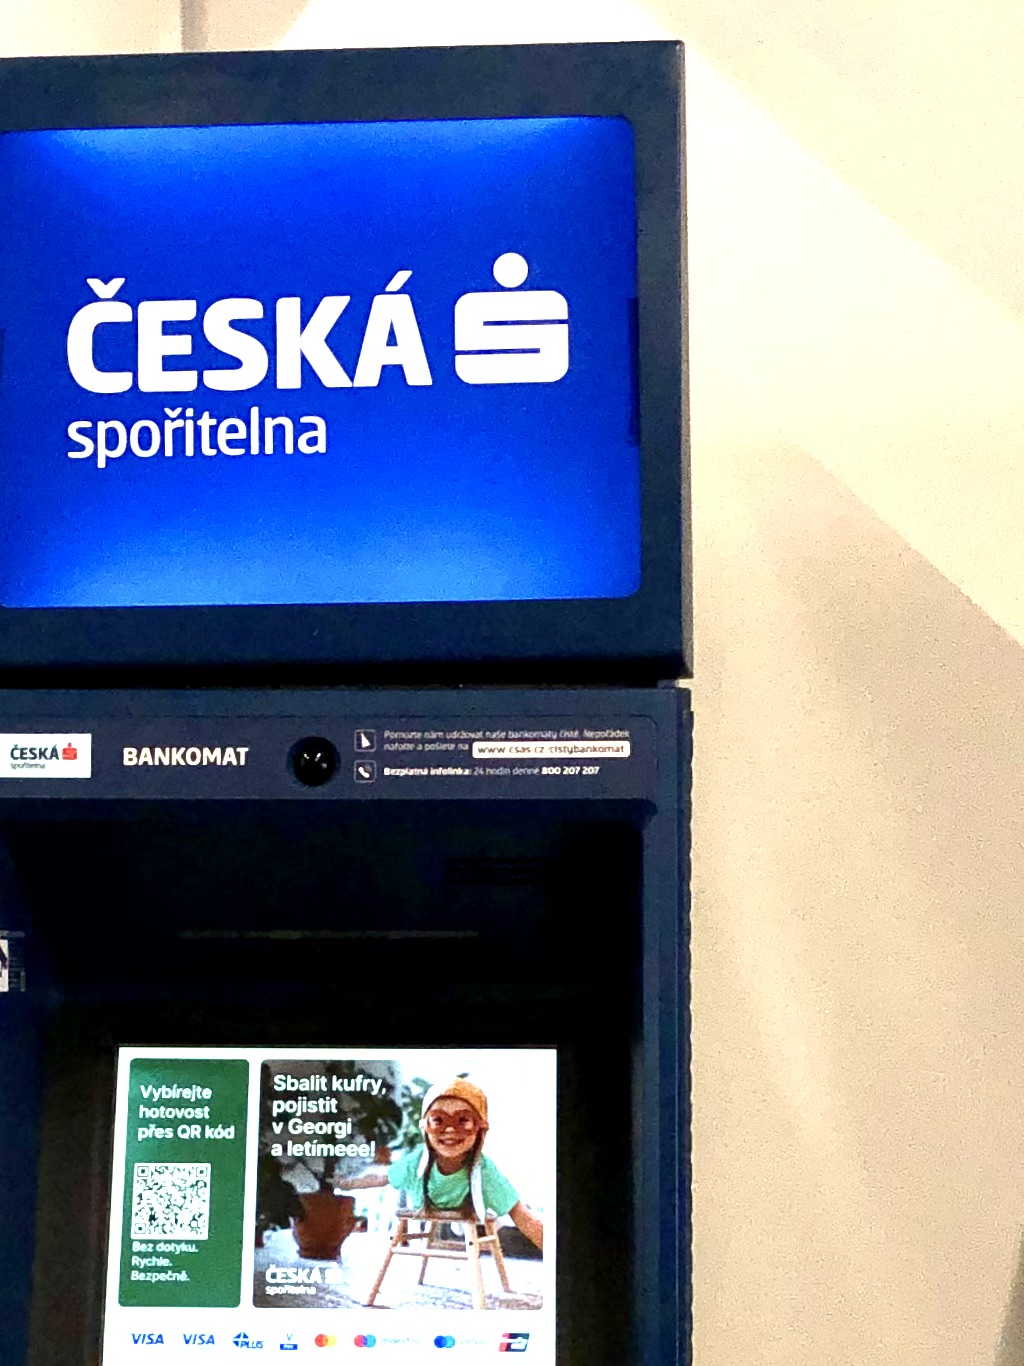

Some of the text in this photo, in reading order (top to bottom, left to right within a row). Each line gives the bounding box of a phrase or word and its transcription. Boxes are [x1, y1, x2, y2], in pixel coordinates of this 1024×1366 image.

[67, 270, 433, 394] ČESKÁ
[67, 406, 328, 468] spořitelna
[10, 744, 59, 761] ČESKÁ
[123, 747, 249, 766] BANKOMAT
[541, 766, 561, 775] 800
[562, 766, 581, 775] 207
[582, 766, 600, 775] 207
[140, 1083, 213, 1102] Vybírejte
[273, 1074, 387, 1096] Sbalit kufry,
[138, 1104, 211, 1119] hotovost
[272, 1096, 338, 1117] pojistit
[137, 1123, 235, 1141] přes QR kód
[271, 1117, 353, 1139] v Georgi
[270, 1139, 376, 1157] a letímeee!
[132, 1240, 154, 1252] Bez
[265, 1264, 323, 1284] ČESKÁ
[131, 1333, 164, 1345] VISA
[182, 1333, 215, 1345] VISA
